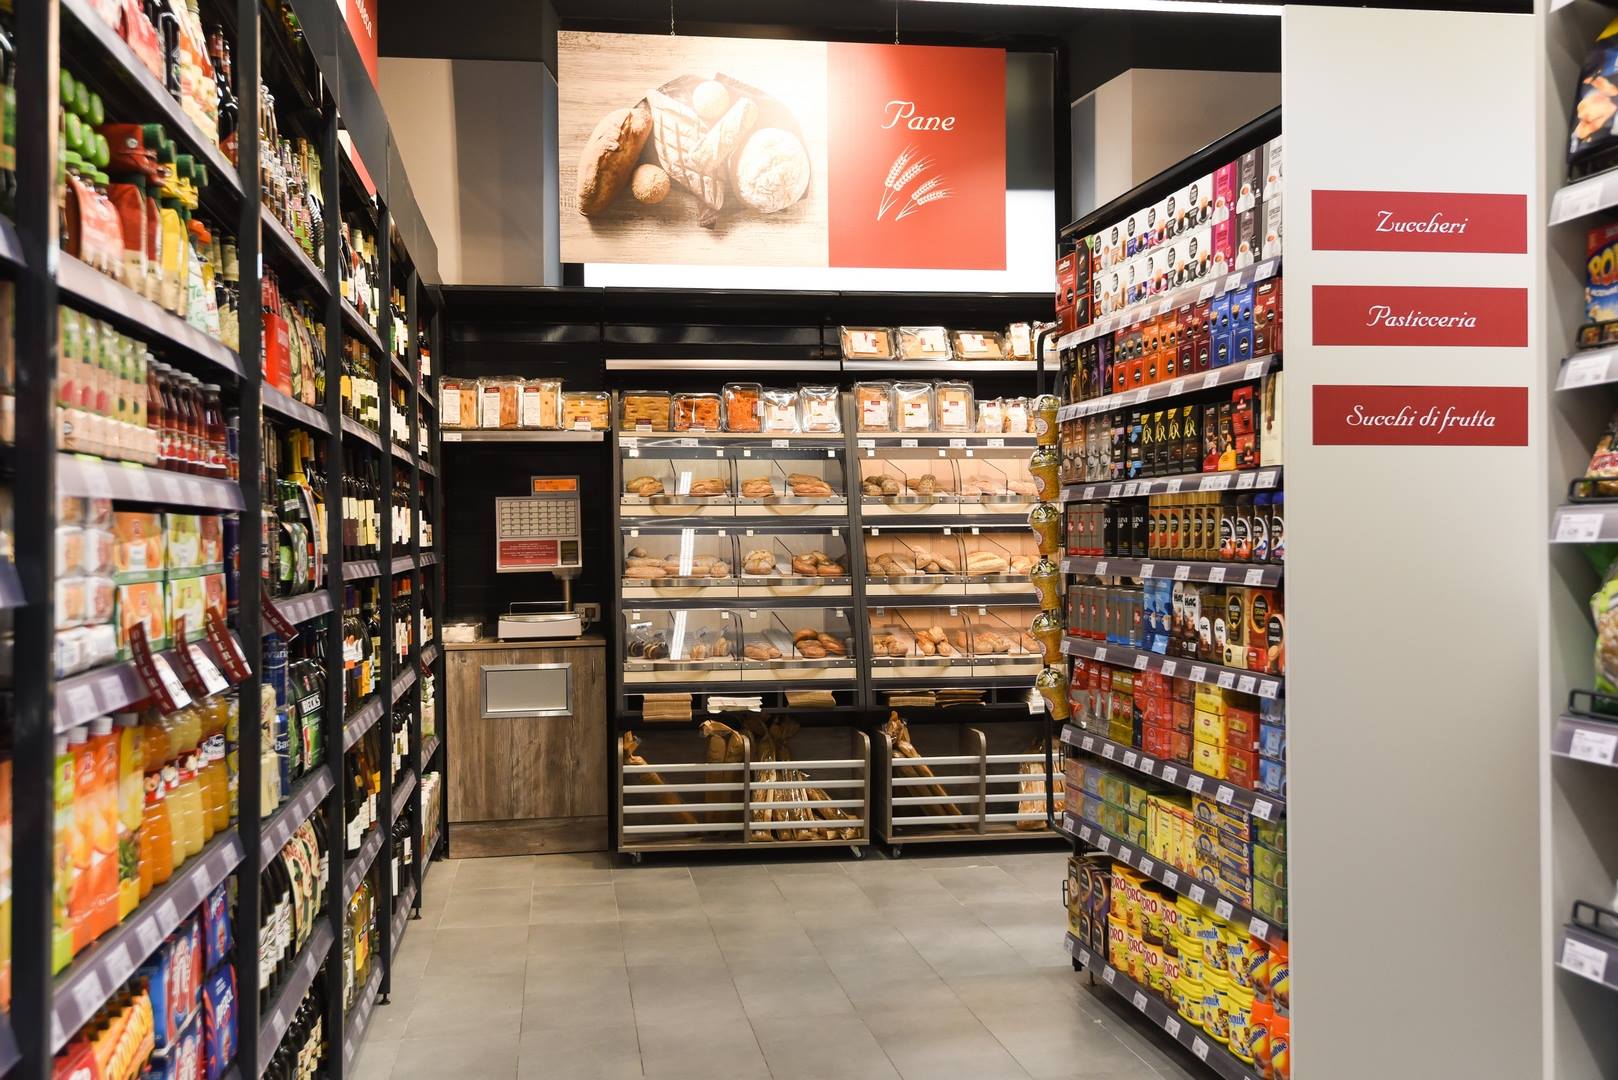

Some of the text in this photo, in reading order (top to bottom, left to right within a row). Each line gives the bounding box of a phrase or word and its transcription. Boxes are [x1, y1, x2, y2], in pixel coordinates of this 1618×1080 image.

[880, 100, 956, 131] Pane
[1375, 210, 1469, 234] Zuccheri
[1366, 305, 1477, 328] Pasticceria
[1346, 404, 1496, 434] Succhi di frutta
